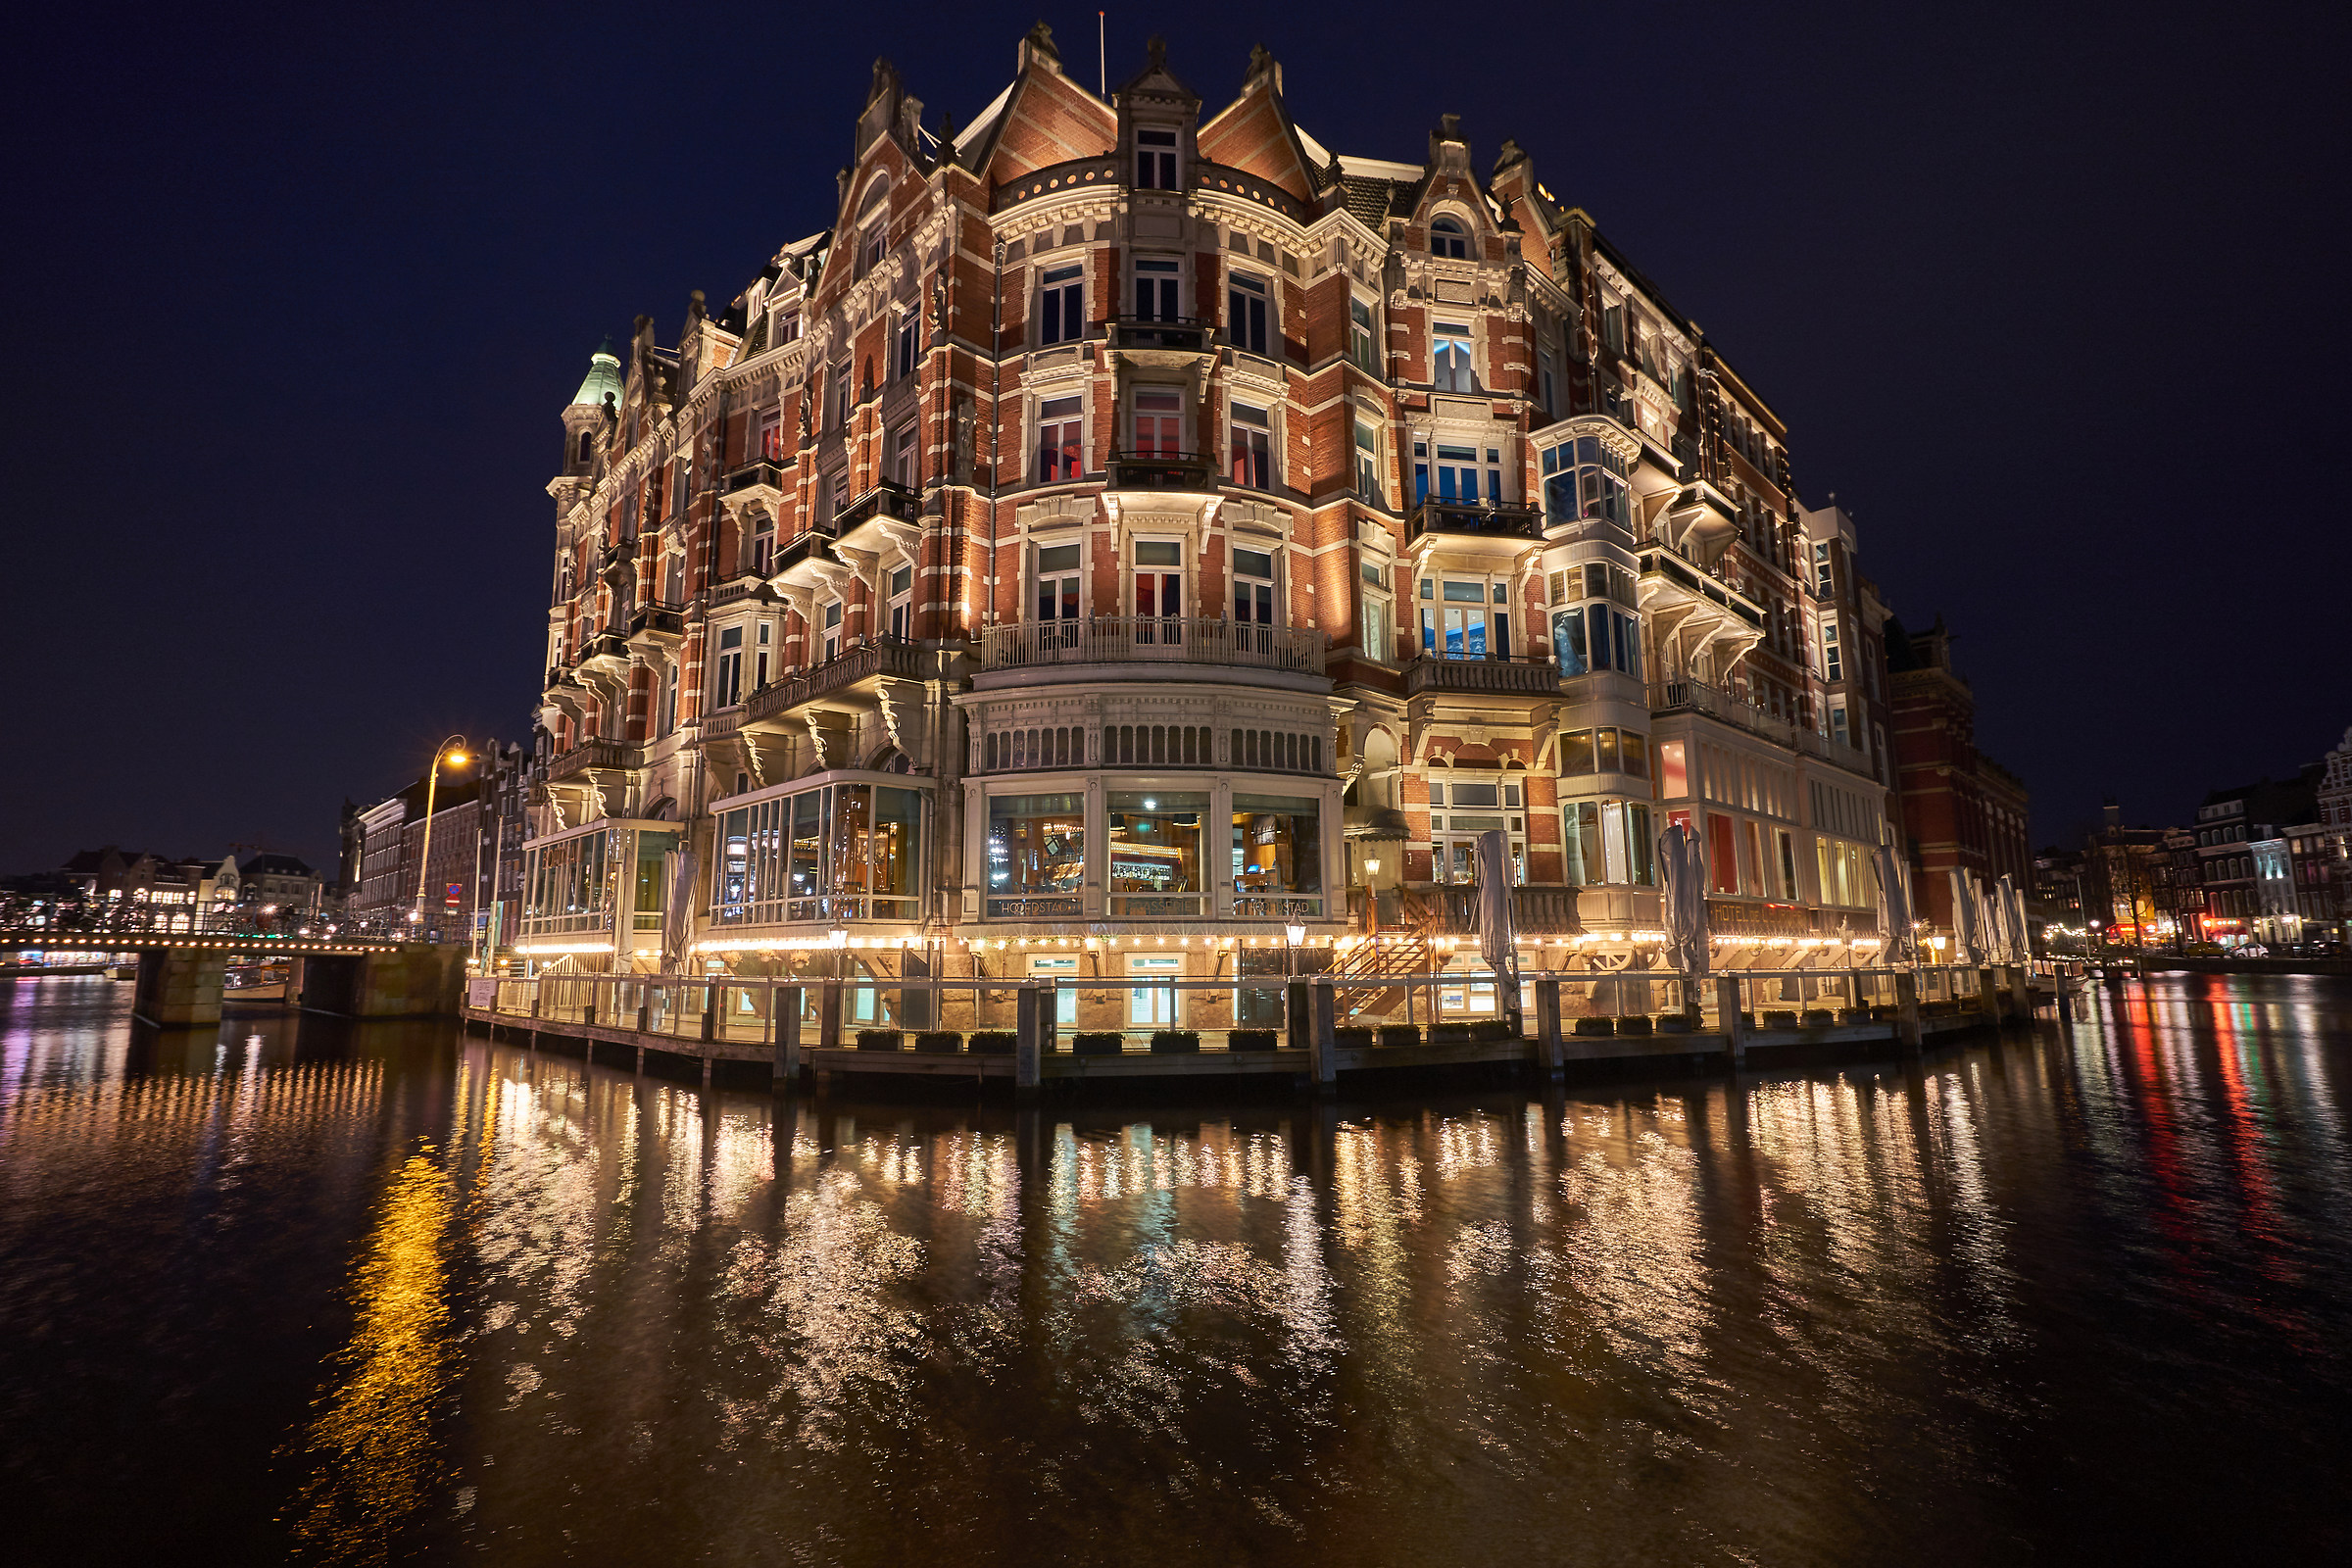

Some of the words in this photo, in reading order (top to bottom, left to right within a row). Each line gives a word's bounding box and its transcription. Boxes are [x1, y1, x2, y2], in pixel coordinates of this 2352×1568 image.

[1002, 902, 1067, 913] HOOFDSTAD
[1249, 902, 1309, 913] HOODSTAD
[1714, 905, 1748, 922] HOTEL
